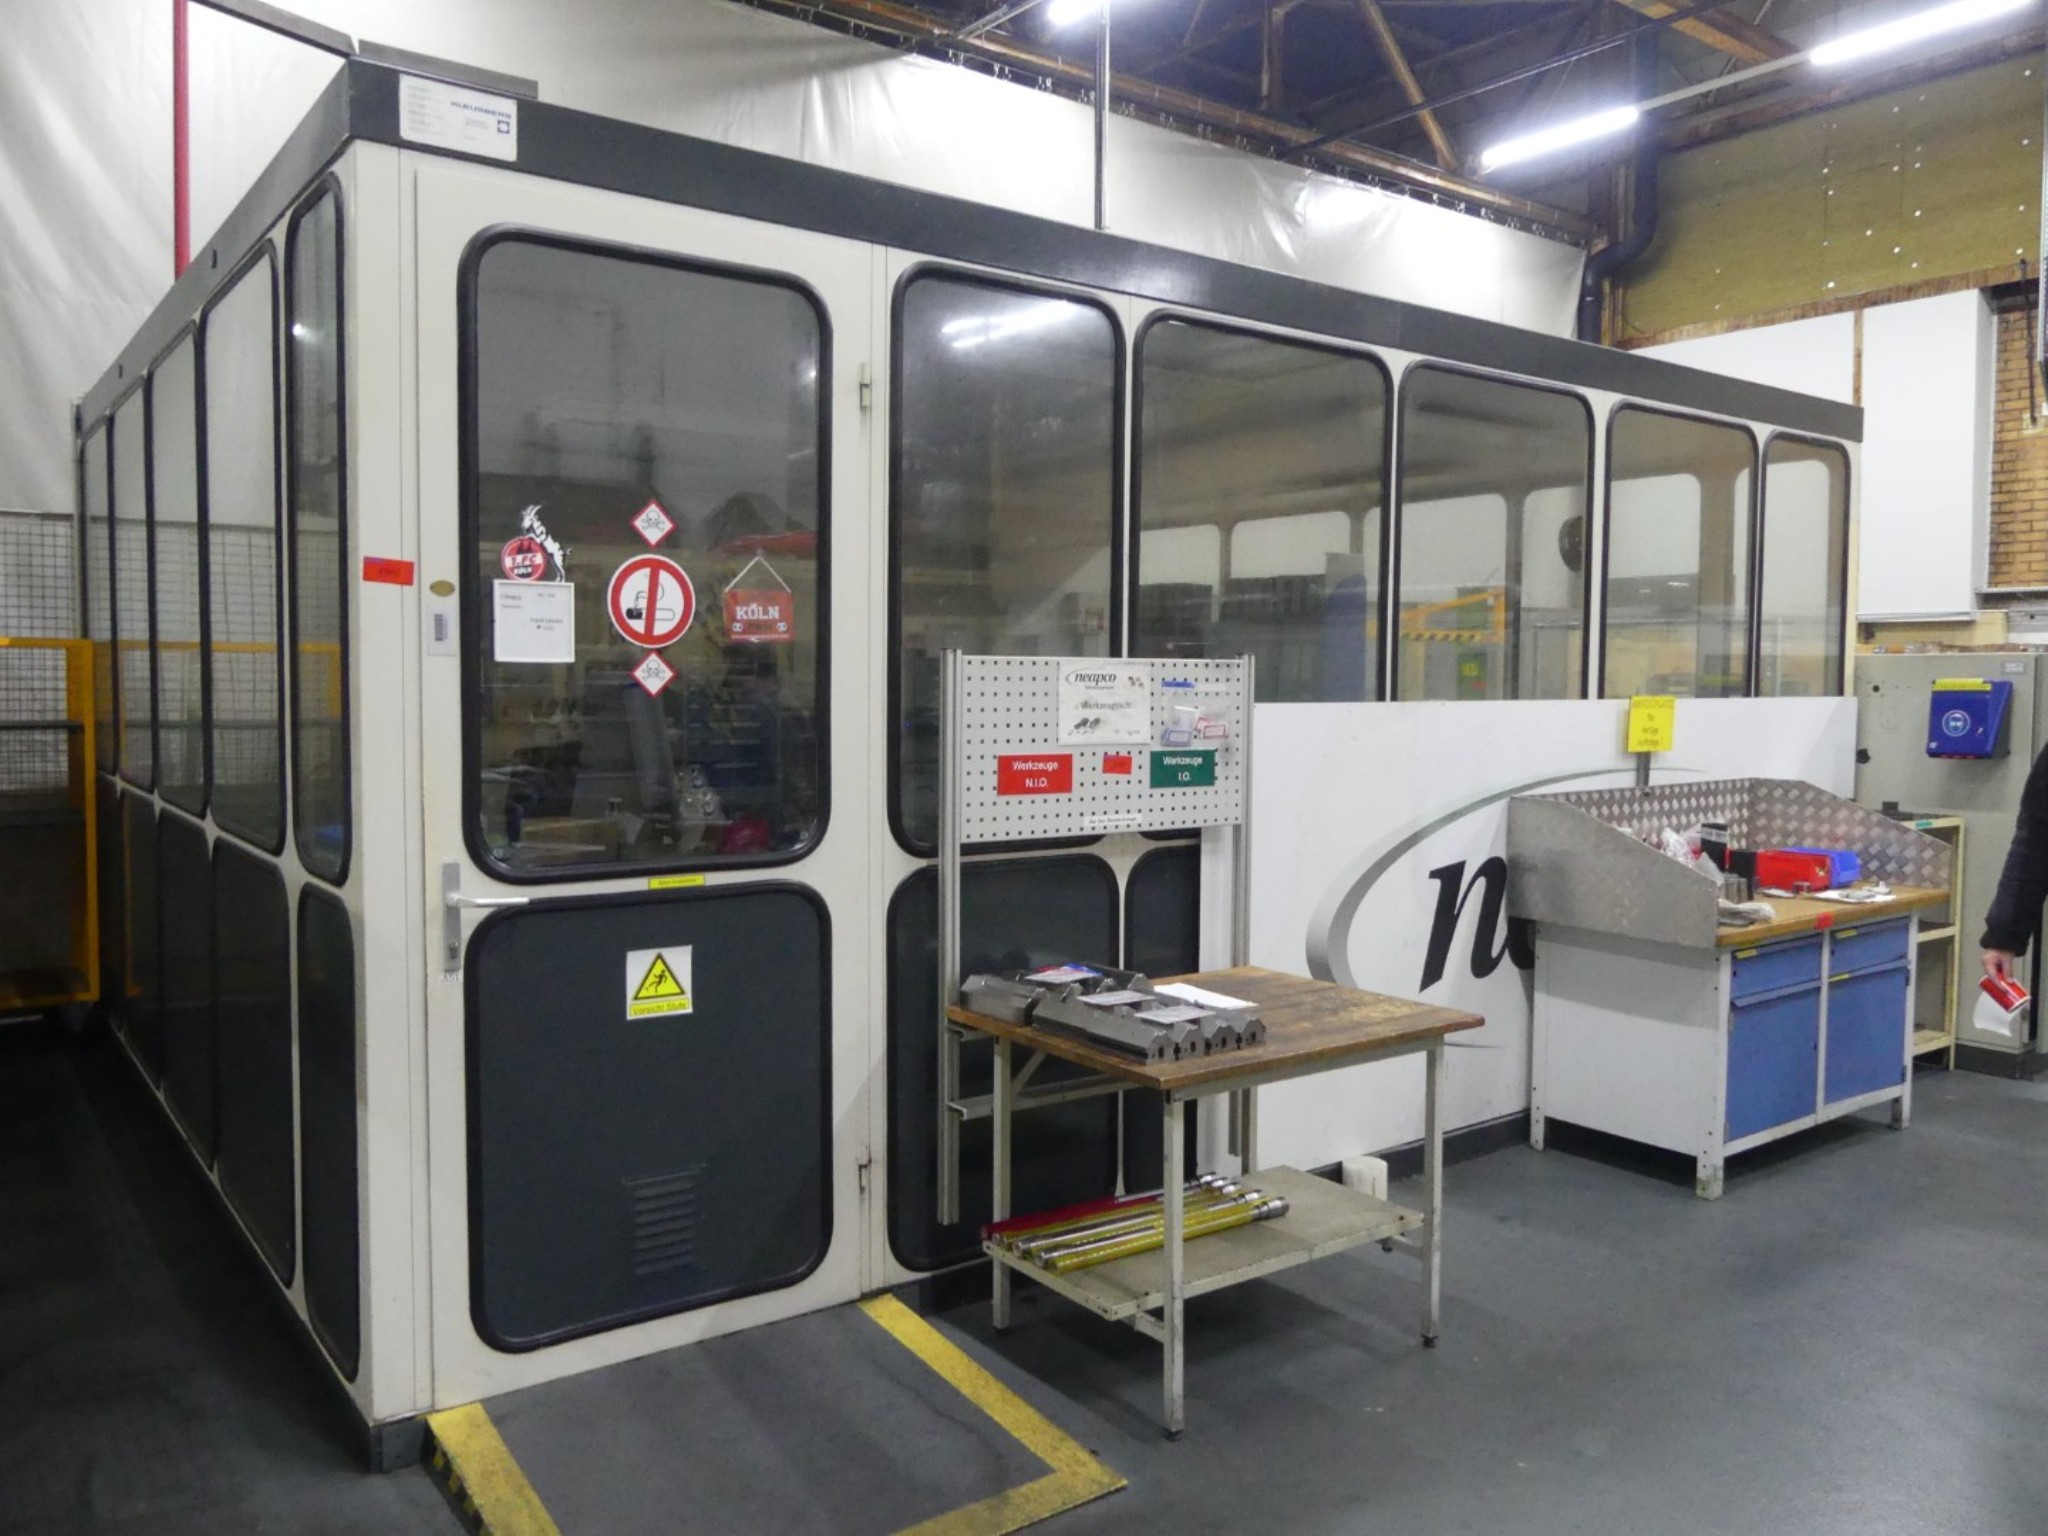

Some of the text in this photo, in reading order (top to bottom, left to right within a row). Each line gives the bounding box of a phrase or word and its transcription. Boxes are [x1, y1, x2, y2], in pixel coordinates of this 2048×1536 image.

[736, 603, 780, 619] KÖLN
[1074, 672, 1117, 686] neapco
[1012, 760, 1059, 771] Werkzeuge
[1162, 756, 1203, 767] Werkzeuge
